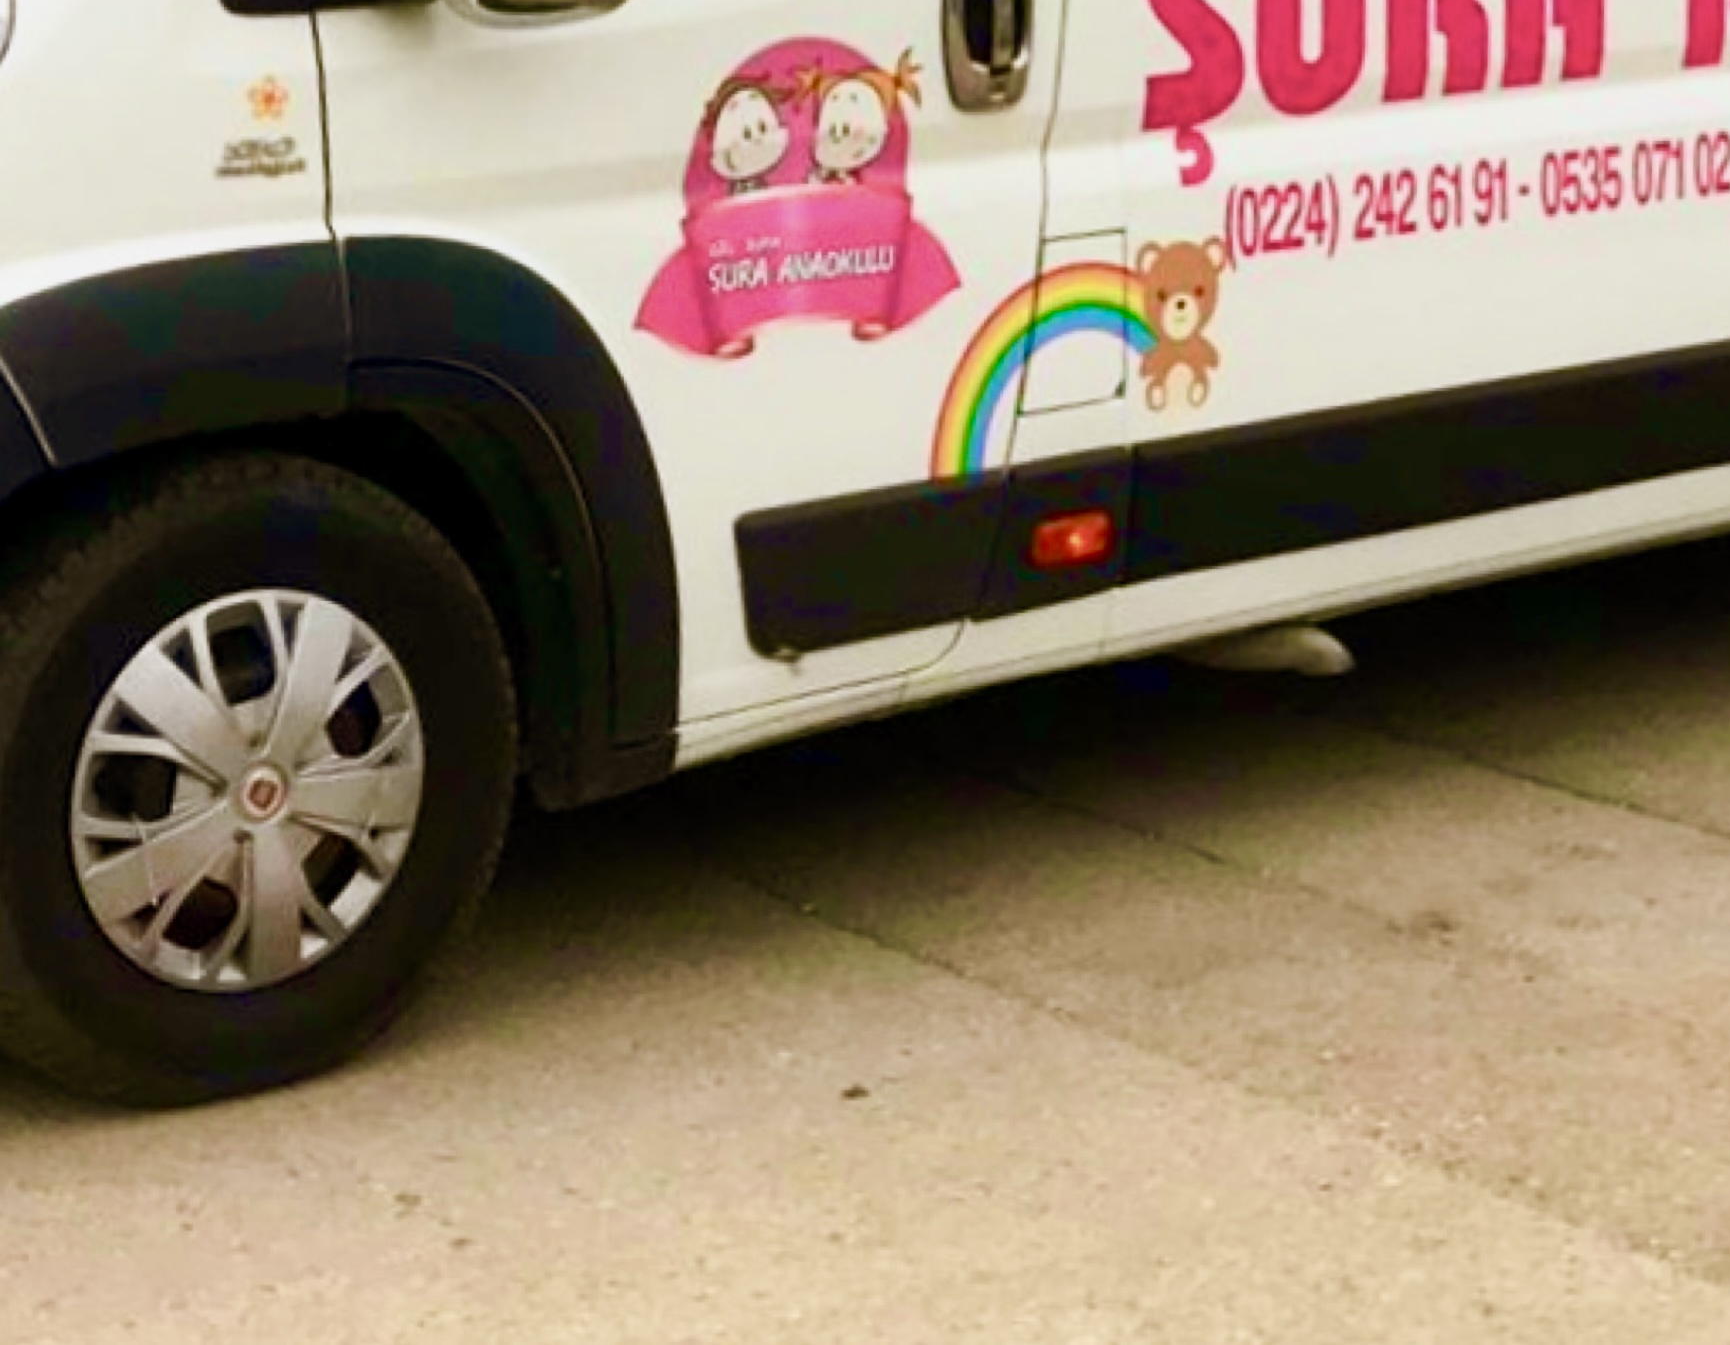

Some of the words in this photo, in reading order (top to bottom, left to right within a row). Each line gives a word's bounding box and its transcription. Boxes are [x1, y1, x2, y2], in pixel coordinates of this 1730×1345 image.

[1226, 174, 1341, 271] (0224)
[1353, 169, 1418, 240] 242
[1426, 163, 1464, 232] 61
[1472, 158, 1509, 226] 91
[1540, 144, 1623, 217] 0535
[1632, 139, 1686, 206] 071
[777, 244, 895, 285] ANAOKULU
